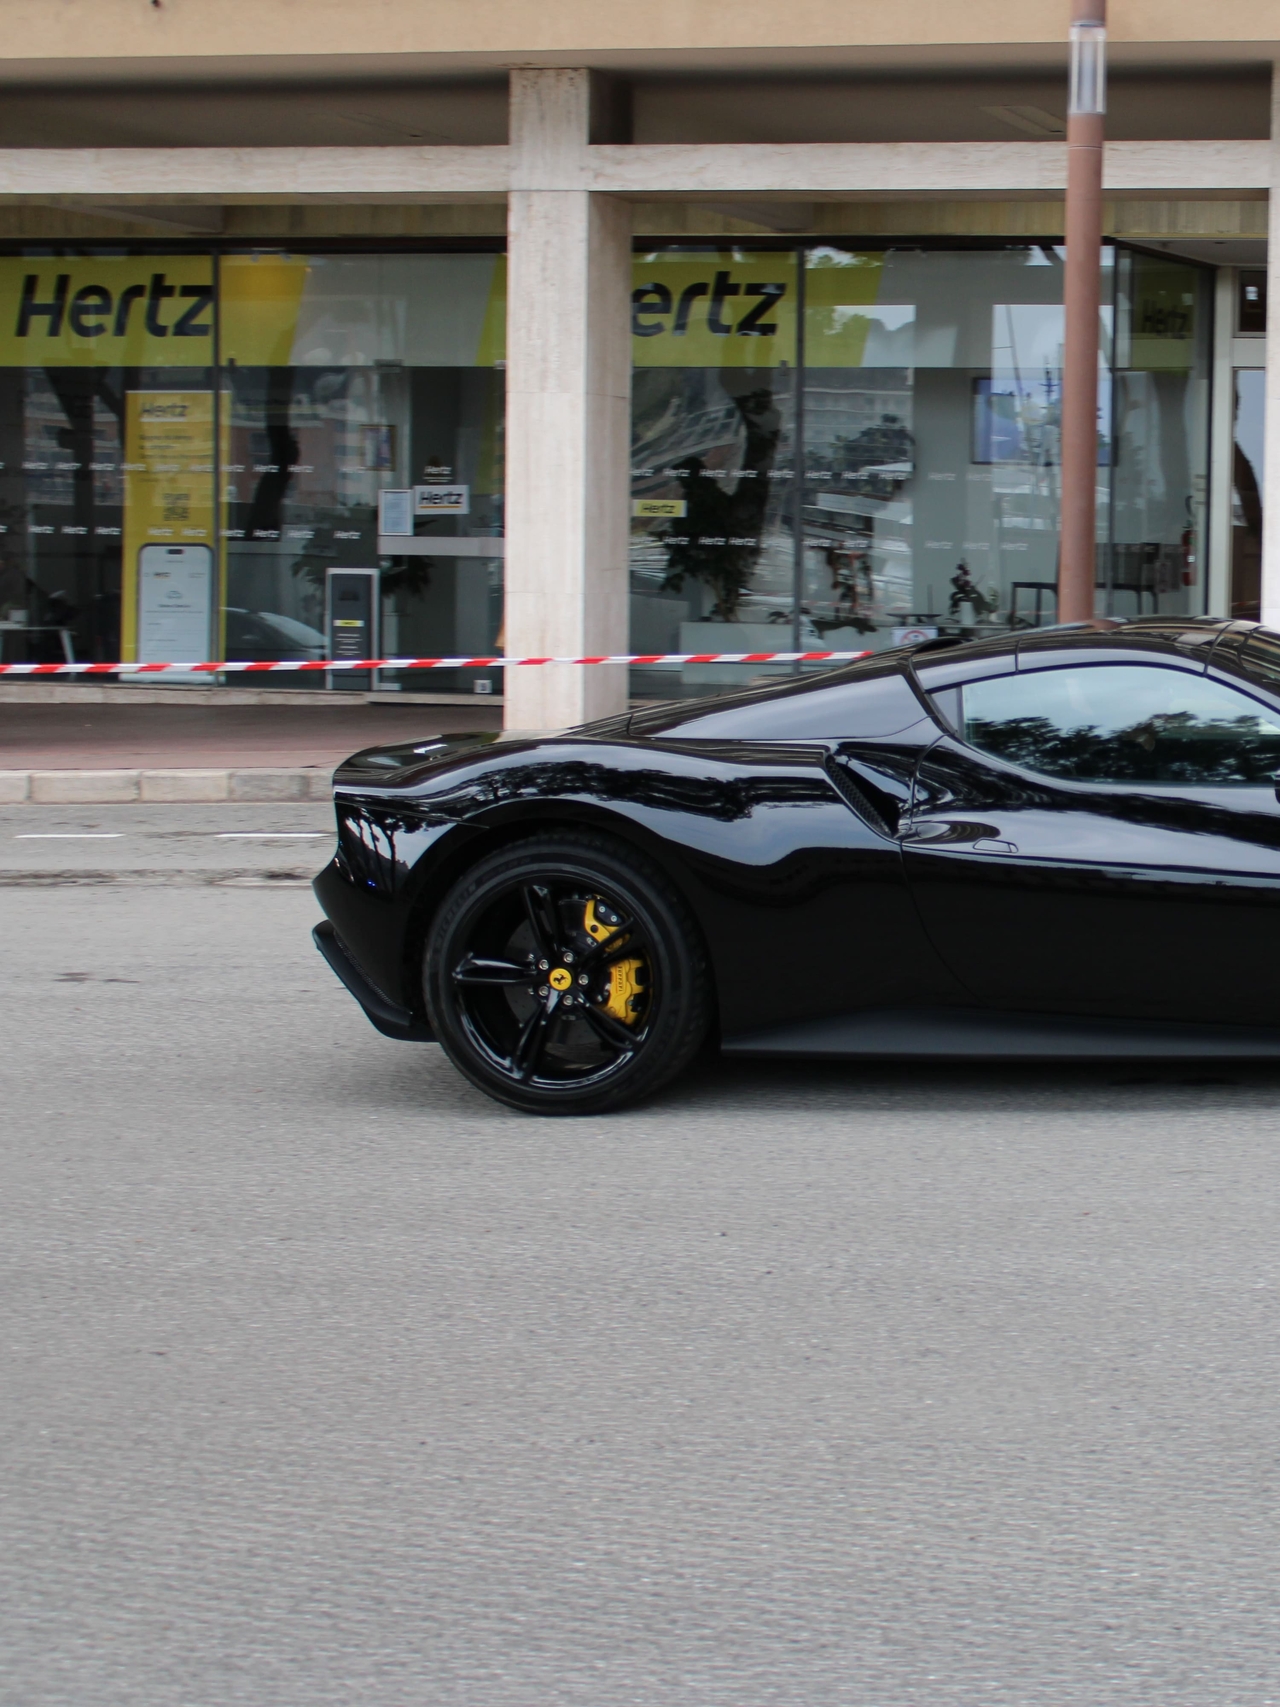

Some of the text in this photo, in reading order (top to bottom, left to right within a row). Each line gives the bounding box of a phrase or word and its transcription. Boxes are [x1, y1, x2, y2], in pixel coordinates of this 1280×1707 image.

[15, 273, 214, 337] Hertz
[631, 271, 786, 337] ertz
[142, 403, 189, 418] Hertz
[424, 466, 452, 474] Hertz
[662, 469, 691, 477] Hertz
[700, 469, 727, 478] Hertz
[730, 469, 758, 478] Hertz
[804, 470, 833, 479] Hertz
[841, 471, 869, 480] Hertz
[419, 491, 464, 505] Hertz
[641, 503, 676, 514] Hertz
[253, 529, 280, 538] Hertz
[333, 530, 362, 540] Hertz
[663, 536, 690, 545] Hertz
[699, 536, 726, 545] Hertz
[728, 537, 757, 546] Hertz
